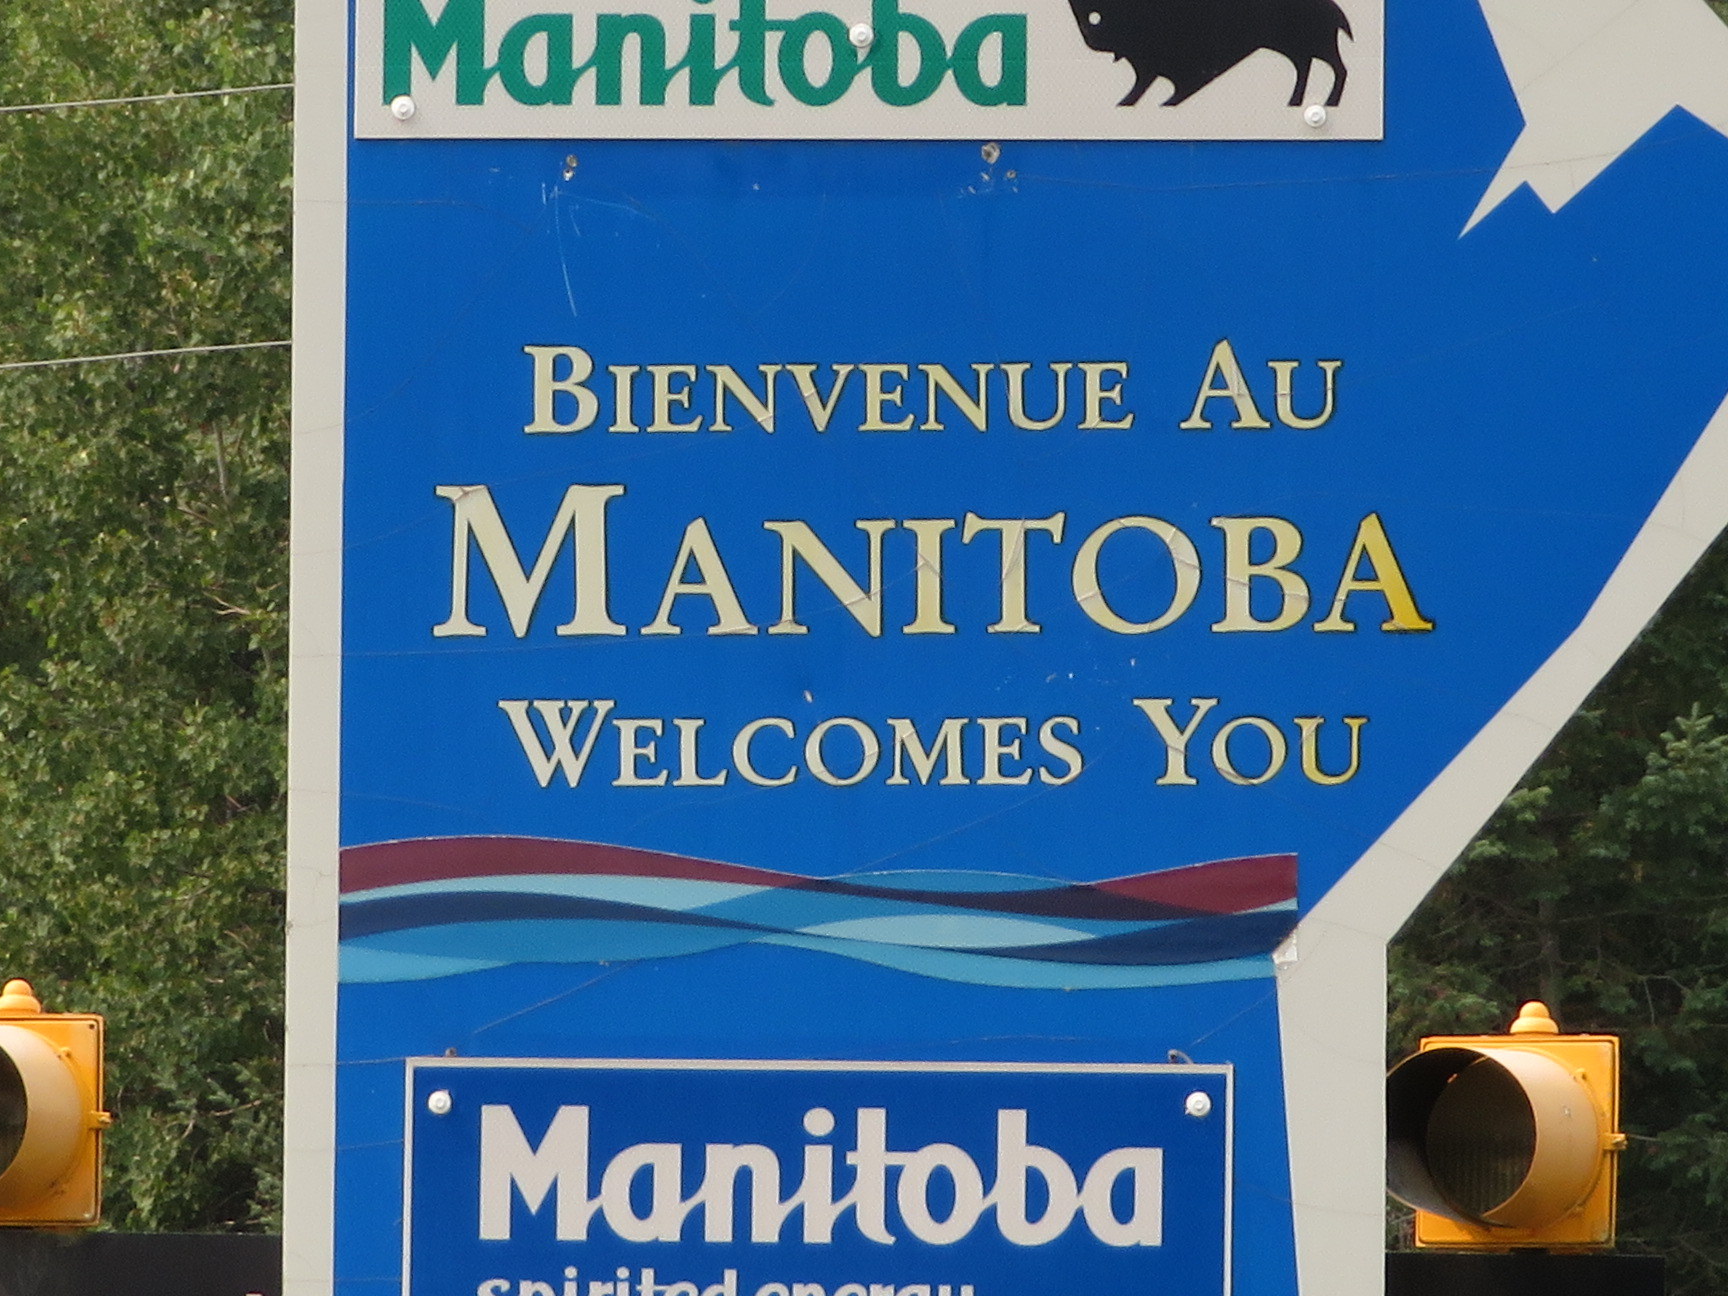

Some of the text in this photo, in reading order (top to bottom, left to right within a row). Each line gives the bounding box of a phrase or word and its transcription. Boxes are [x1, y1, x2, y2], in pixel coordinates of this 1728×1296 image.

[524, 339, 1341, 434] BIENVENUE AU
[433, 484, 1433, 638] MANITOBA
[499, 698, 1368, 788] WELCOMES YOU
[479, 1104, 1163, 1247] Manitoba
